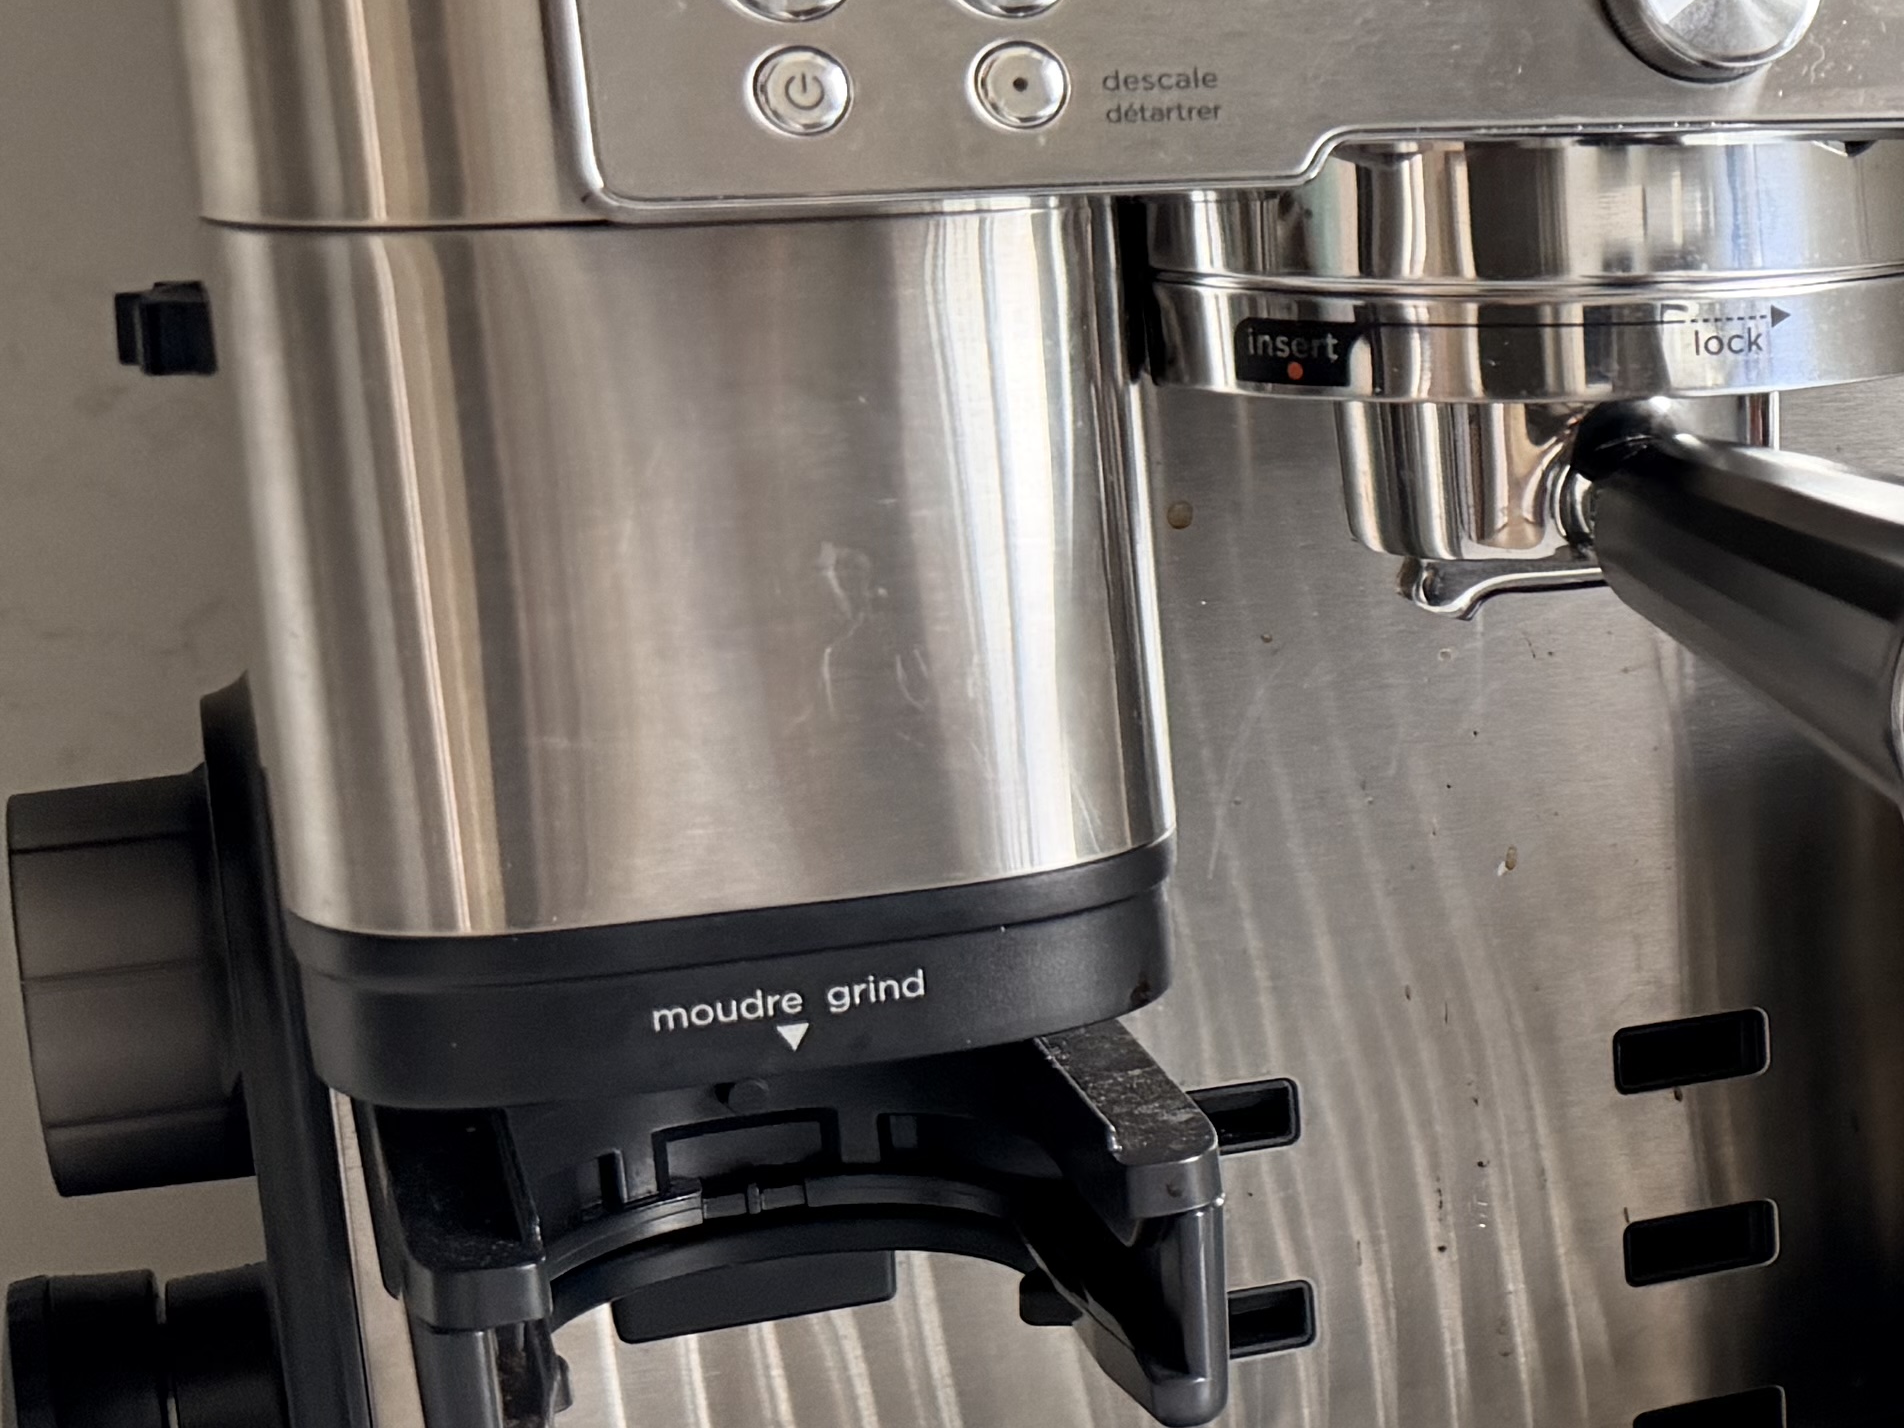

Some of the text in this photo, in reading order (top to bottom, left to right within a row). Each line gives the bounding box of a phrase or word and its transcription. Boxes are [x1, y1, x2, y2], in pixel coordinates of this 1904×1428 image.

[1102, 66, 1218, 92] descale
[1106, 101, 1220, 123] détartrer
[1247, 327, 1339, 363] insert
[1694, 326, 1763, 356] lock
[652, 968, 925, 1032] moudre grind
